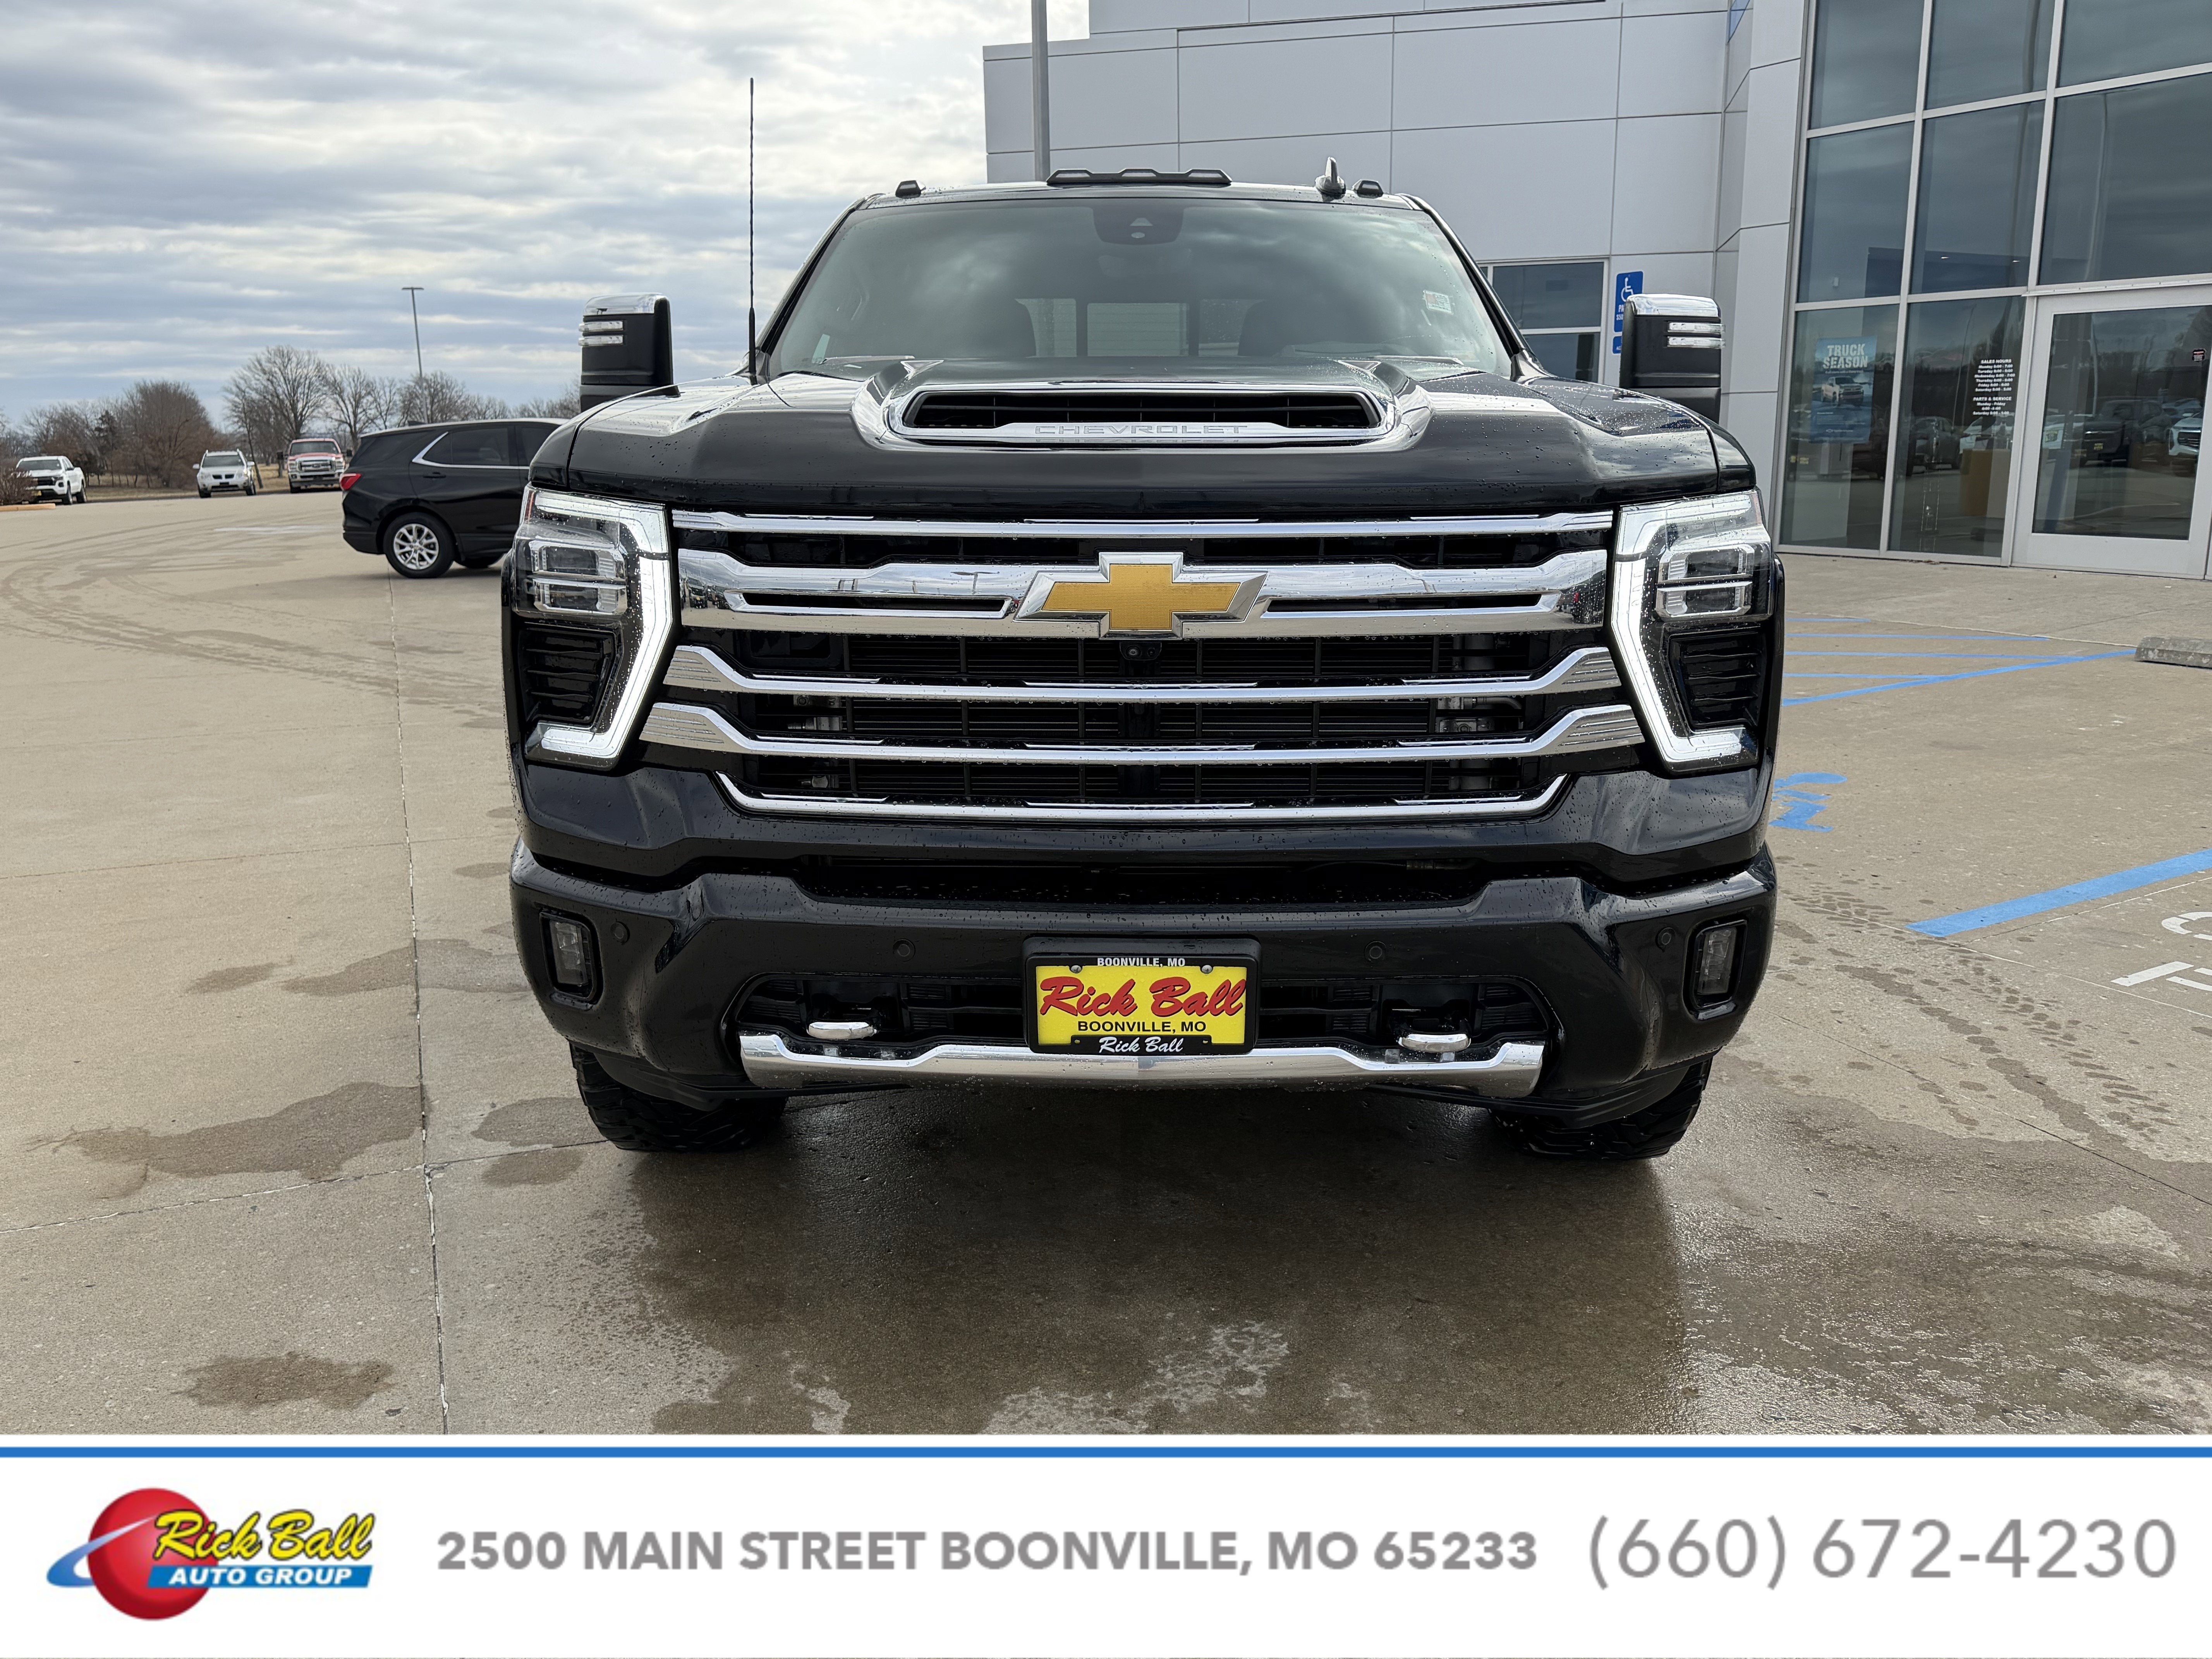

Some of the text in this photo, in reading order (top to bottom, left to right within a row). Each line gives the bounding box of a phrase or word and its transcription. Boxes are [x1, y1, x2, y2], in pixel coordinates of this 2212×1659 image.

[1827, 343, 1865, 357] TRUCK
[1823, 356, 1868, 369] SEASON
[1034, 426, 1247, 434] CHEVROLET
[1097, 958, 1185, 968] BOONVILLE, MO
[1040, 976, 1246, 1017] Rick Ball
[1078, 1021, 1206, 1033] BOONVILLE, MO
[1099, 1037, 1183, 1053] Rick Ball
